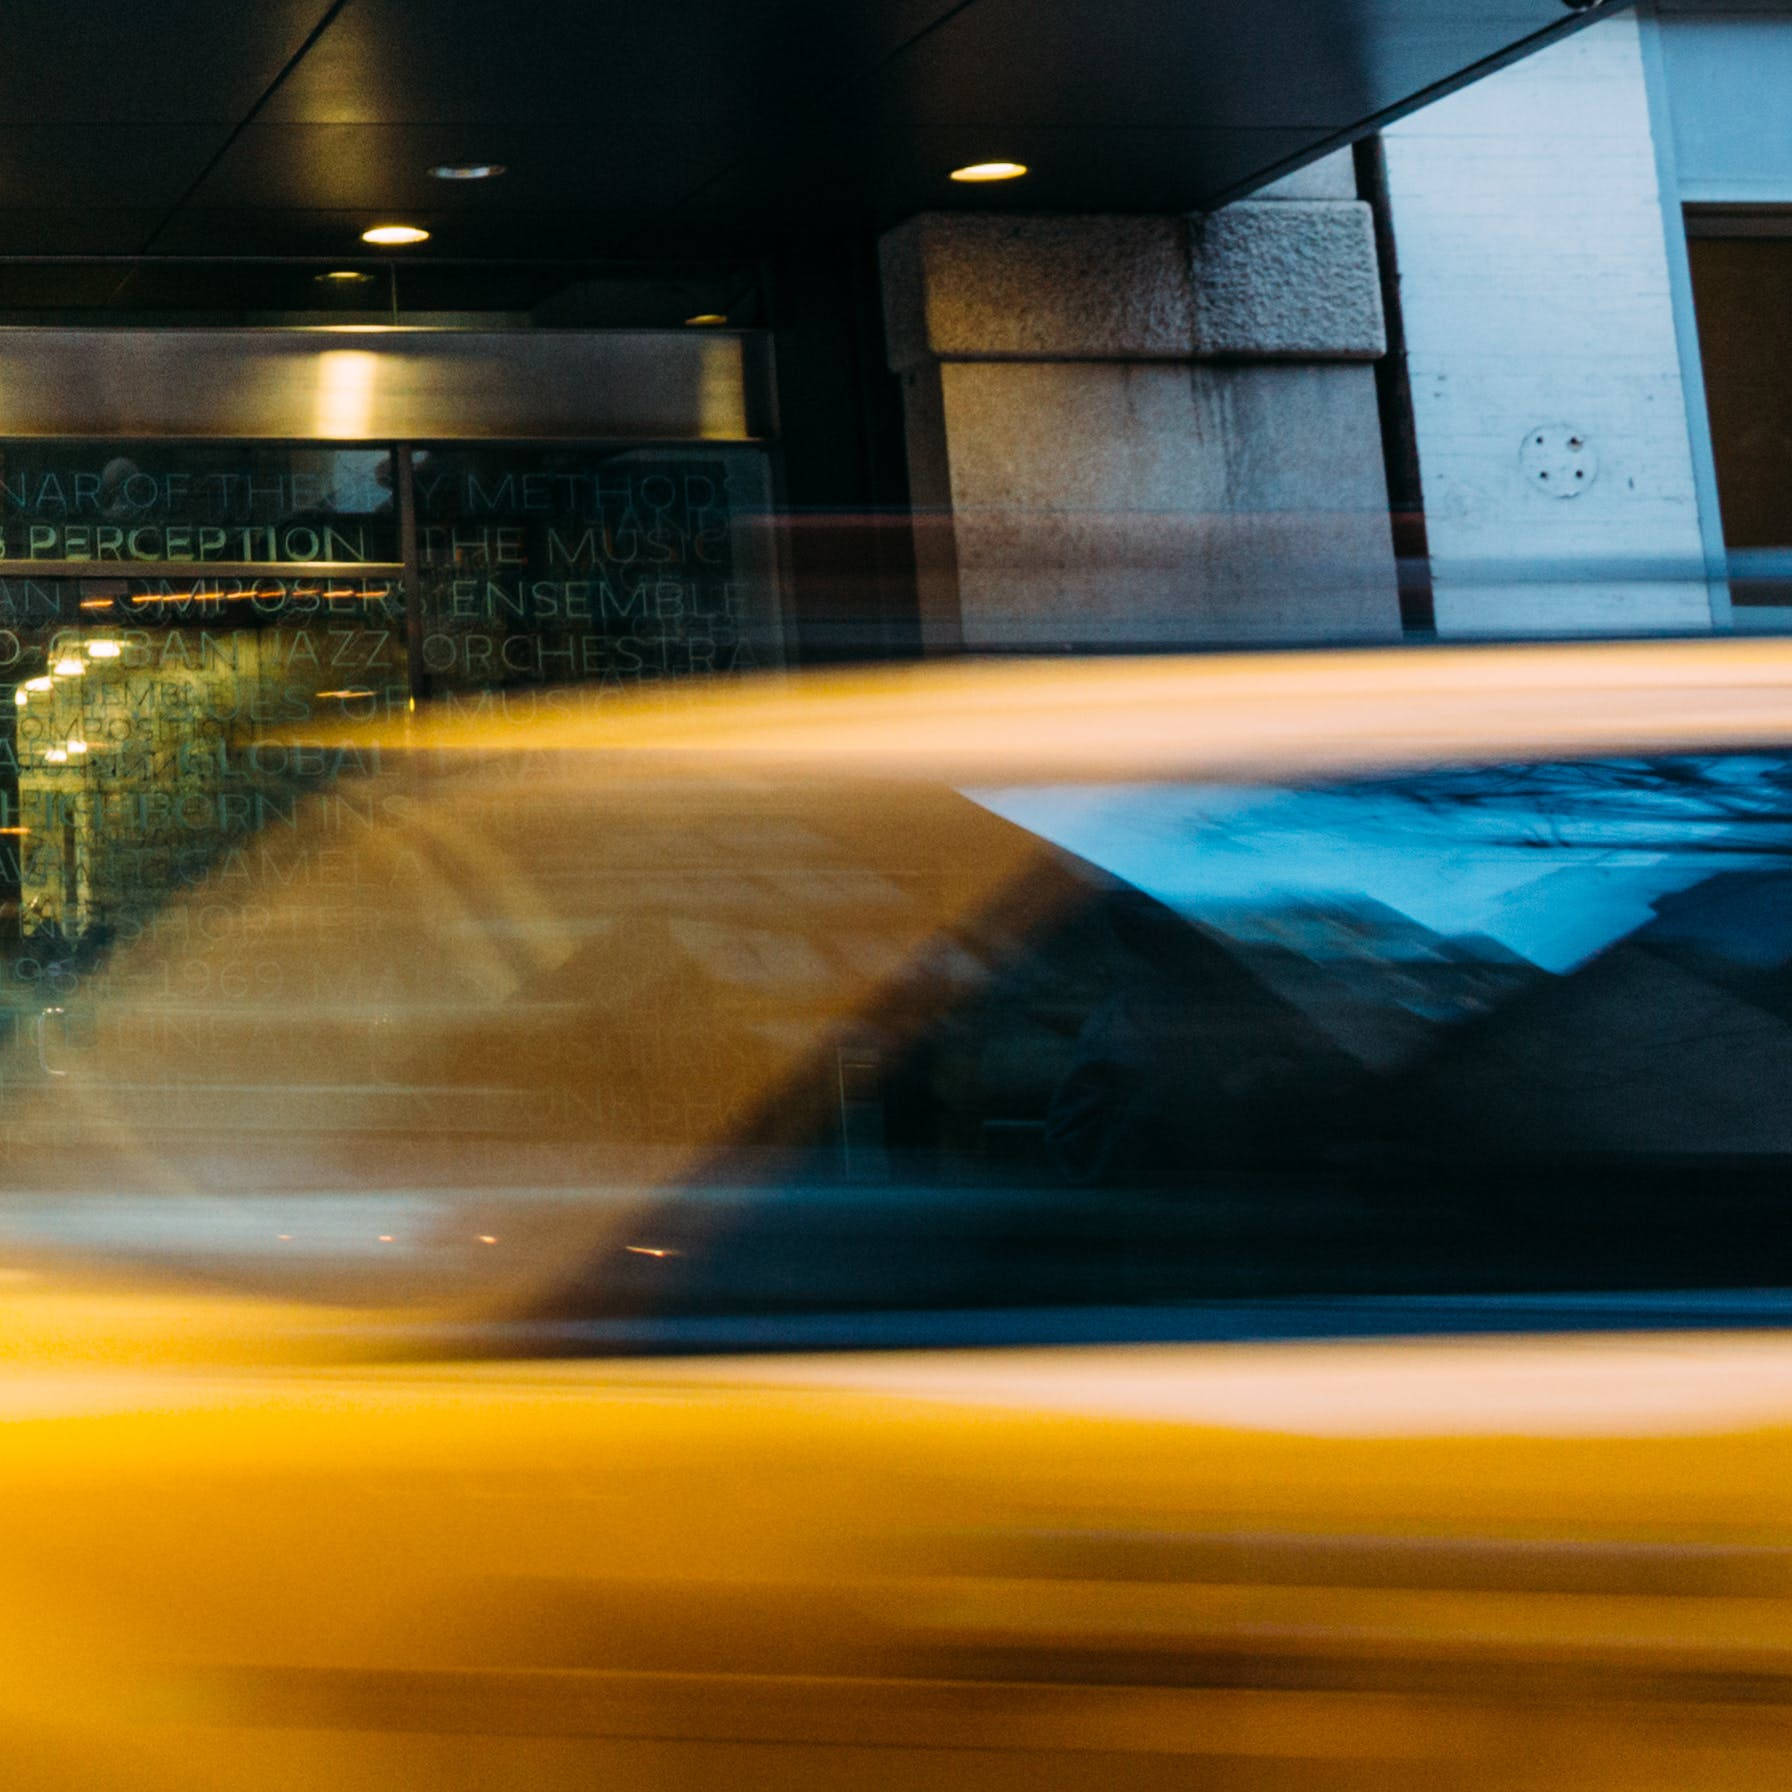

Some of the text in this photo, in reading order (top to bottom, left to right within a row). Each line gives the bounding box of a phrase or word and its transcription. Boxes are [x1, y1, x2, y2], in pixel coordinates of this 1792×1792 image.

[124, 472, 189, 509] OF
[29, 524, 368, 562] PERCEPTION
[424, 525, 527, 565] THE
[421, 634, 761, 675] ORCHESTRA
